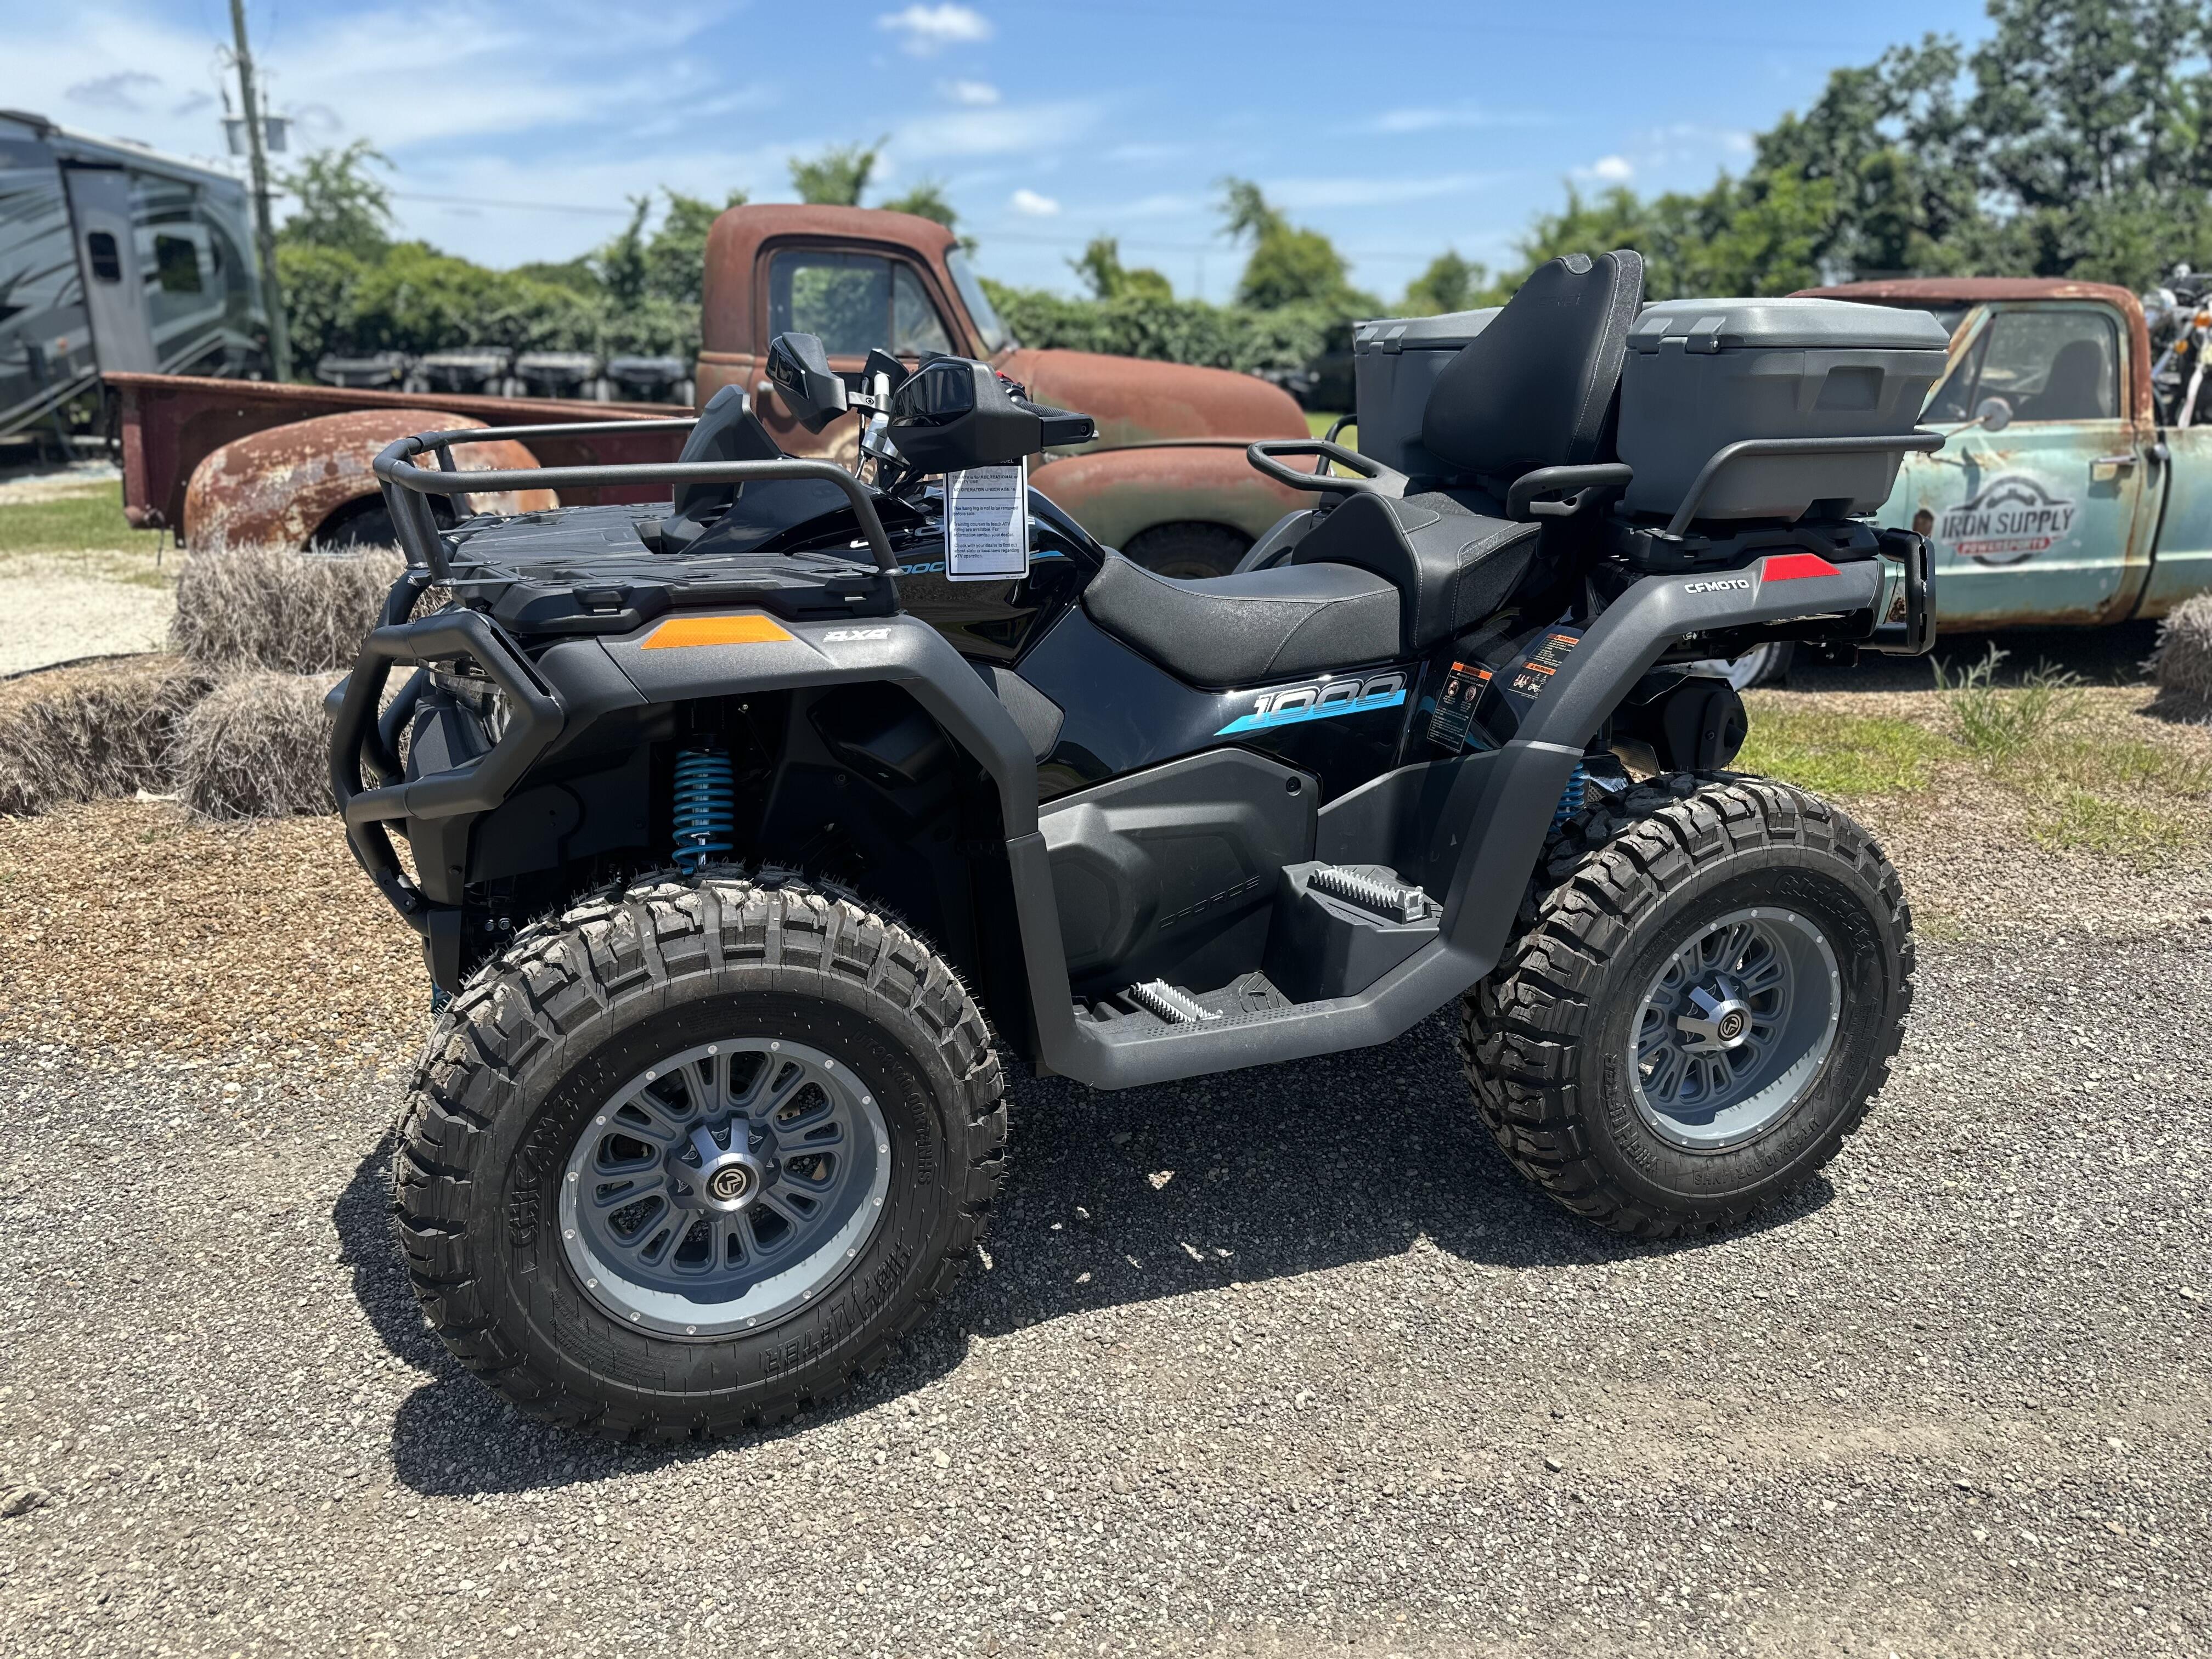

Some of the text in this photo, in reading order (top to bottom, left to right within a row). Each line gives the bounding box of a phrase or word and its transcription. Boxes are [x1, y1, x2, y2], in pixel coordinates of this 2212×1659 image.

[1942, 507, 2075, 539] IRON SUPPLY
[1684, 579, 1750, 594] CFMOTO
[1249, 672, 1408, 725] 1000
[1158, 874, 1261, 929] CFORCE
